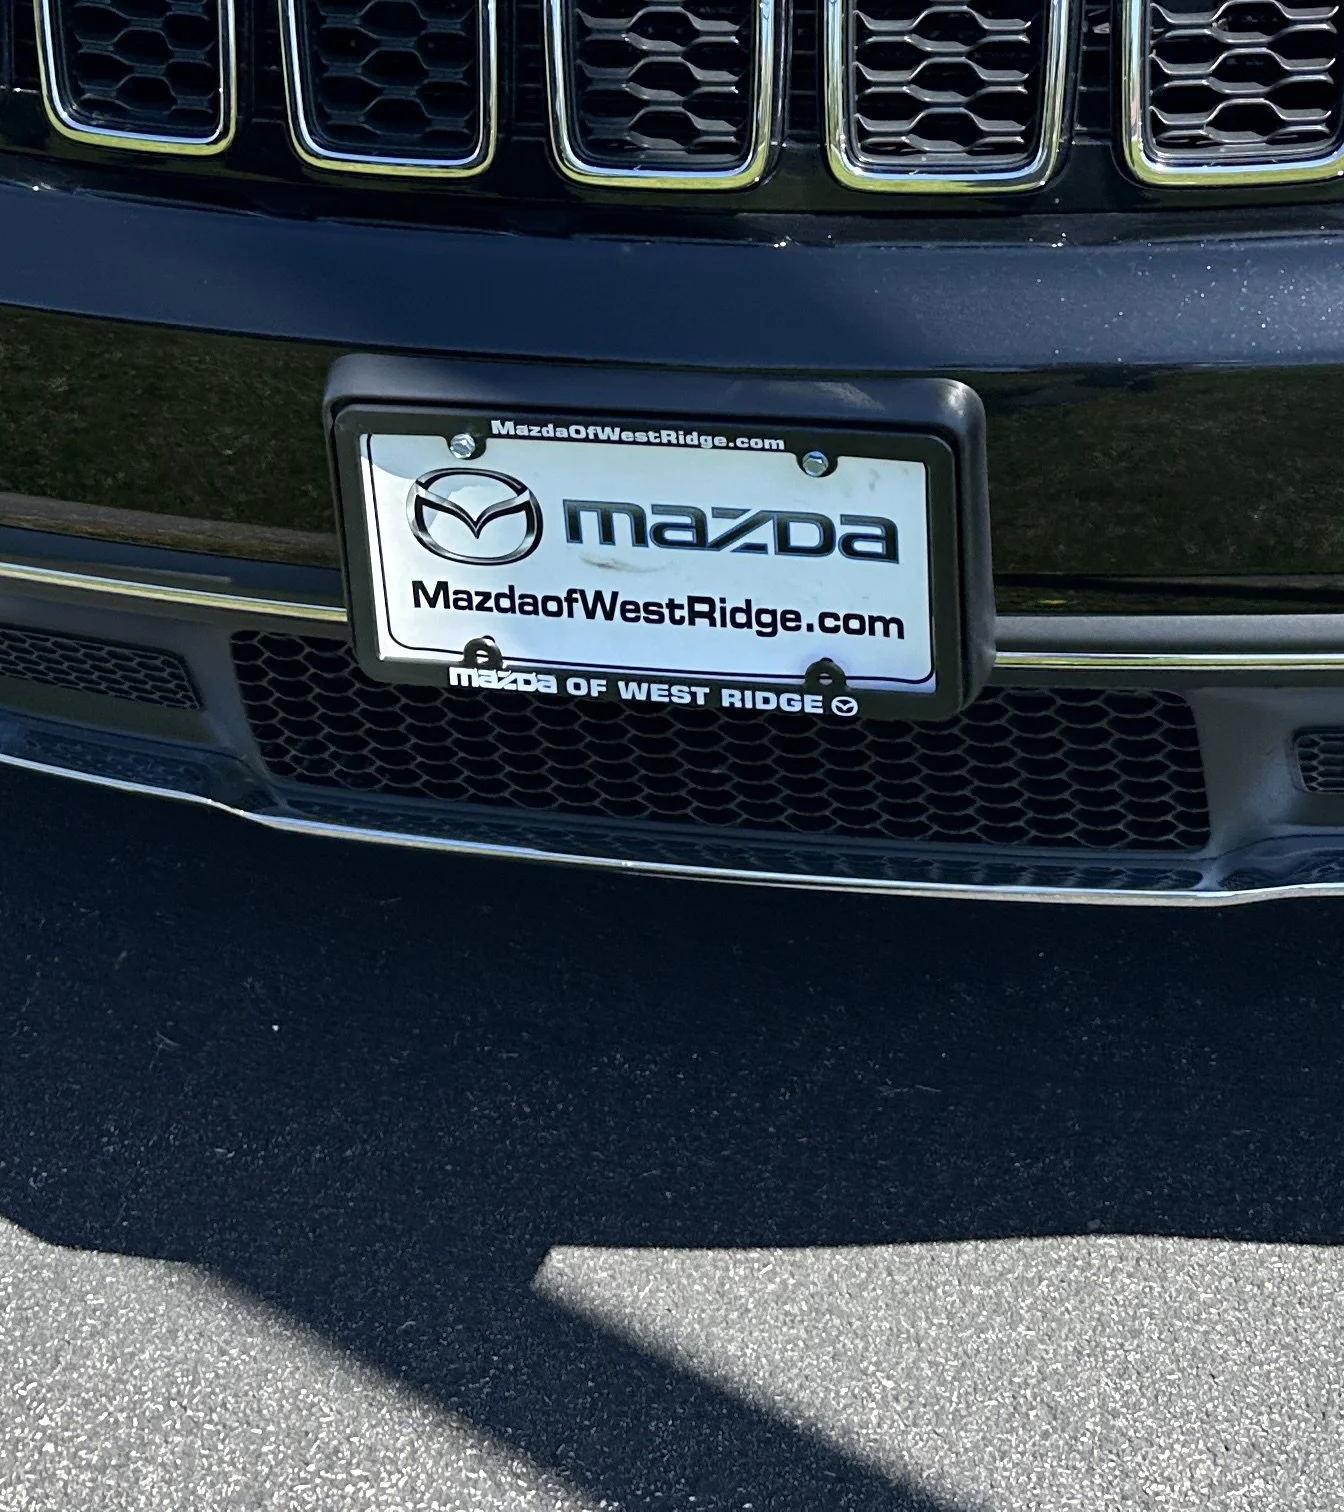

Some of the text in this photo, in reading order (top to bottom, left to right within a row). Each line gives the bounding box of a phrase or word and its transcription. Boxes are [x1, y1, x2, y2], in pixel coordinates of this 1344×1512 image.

[490, 419, 786, 450] MazdaOfWestRidge.com
[562, 498, 901, 565] mazda
[411, 579, 906, 640] MazdaofWestRidge.com
[565, 676, 607, 697] OF
[617, 679, 711, 706] WEST
[720, 687, 824, 715] RIDGE
